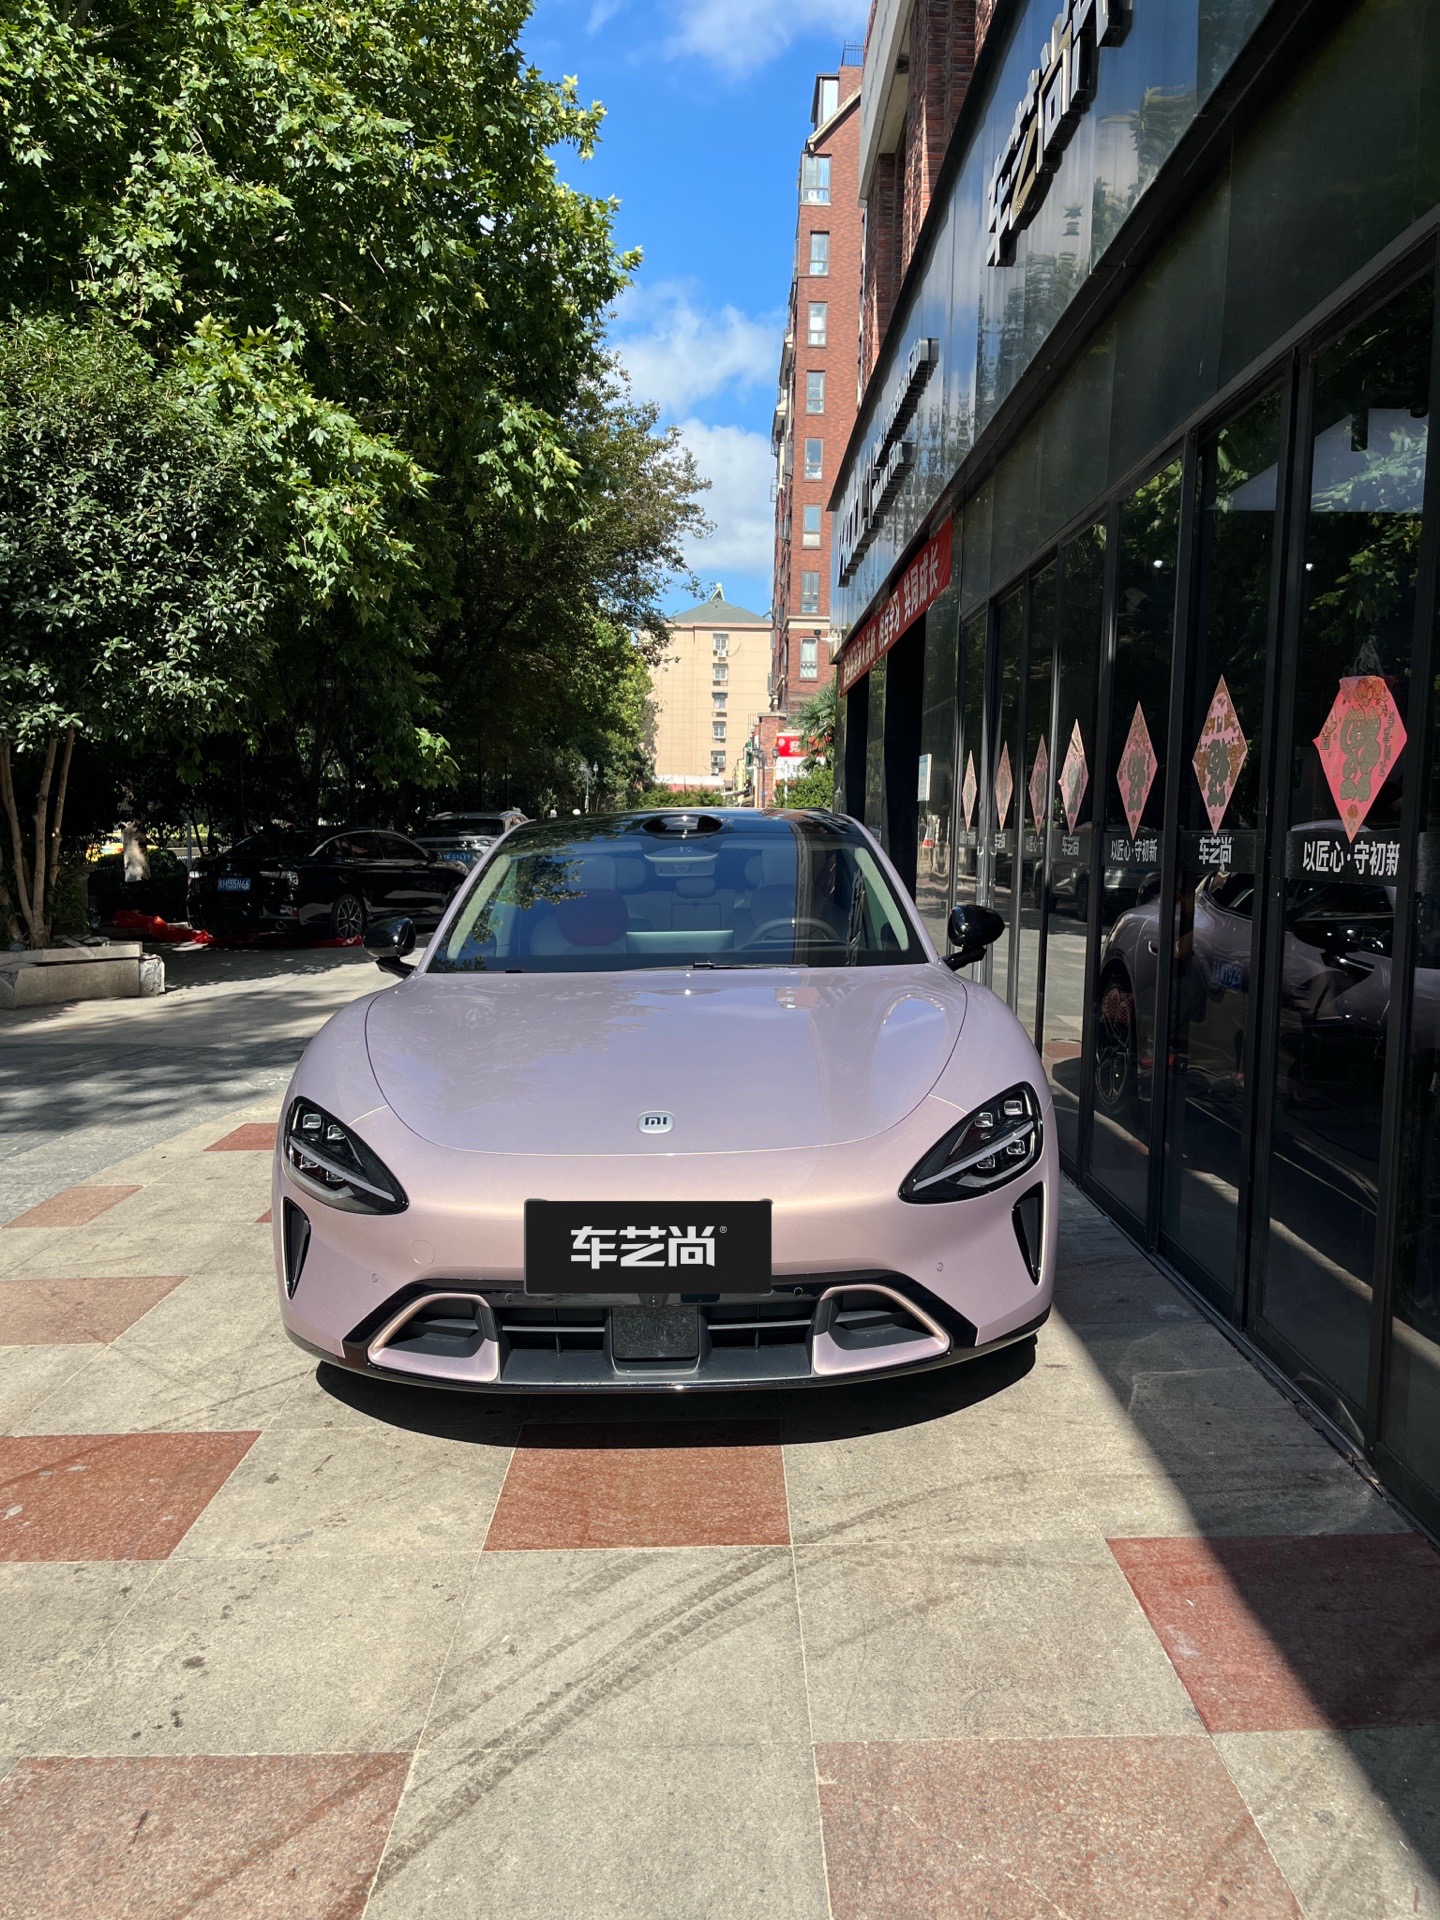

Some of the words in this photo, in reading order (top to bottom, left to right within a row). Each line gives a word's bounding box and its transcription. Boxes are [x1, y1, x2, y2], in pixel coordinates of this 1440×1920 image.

[903, 542, 939, 621] 共同成长
[1199, 836, 1232, 865] 车艺尚
[570, 1225, 716, 1270] 车艺尚
